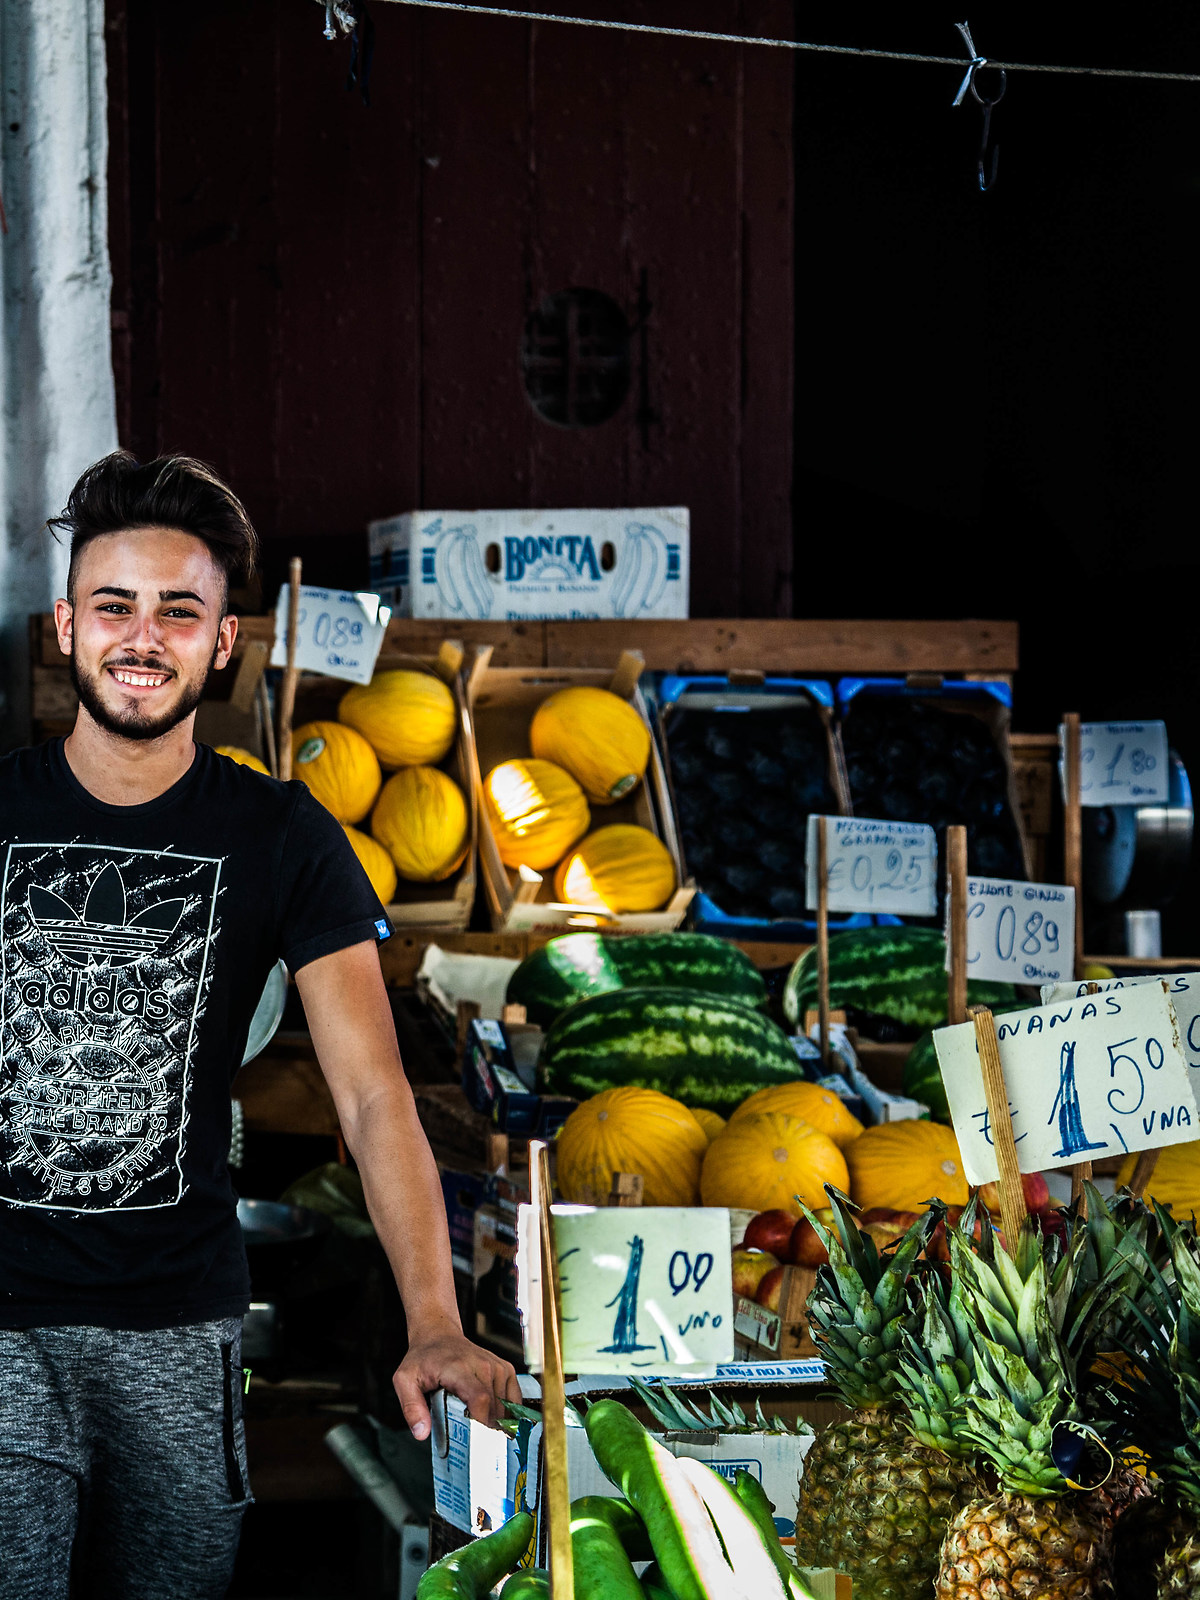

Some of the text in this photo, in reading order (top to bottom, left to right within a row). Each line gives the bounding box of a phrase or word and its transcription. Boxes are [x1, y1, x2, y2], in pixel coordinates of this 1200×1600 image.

[504, 535, 602, 581] BONITA
[968, 882, 1014, 898] ELLONE
[21, 971, 171, 1019] adidas
[978, 997, 1122, 1048] NANAS
[13, 1023, 168, 1108] DIE MARKE MIT DEN
[29, 1084, 146, 1110] 3 STREIFEN
[30, 1106, 143, 1133] THE BRAND
[32, 1157, 74, 1192] THE
[78, 1176, 92, 1196] 3
[98, 1115, 168, 1192] STRIPES
[756, 1366, 786, 1377] YOU
[787, 1365, 825, 1376] HANK
